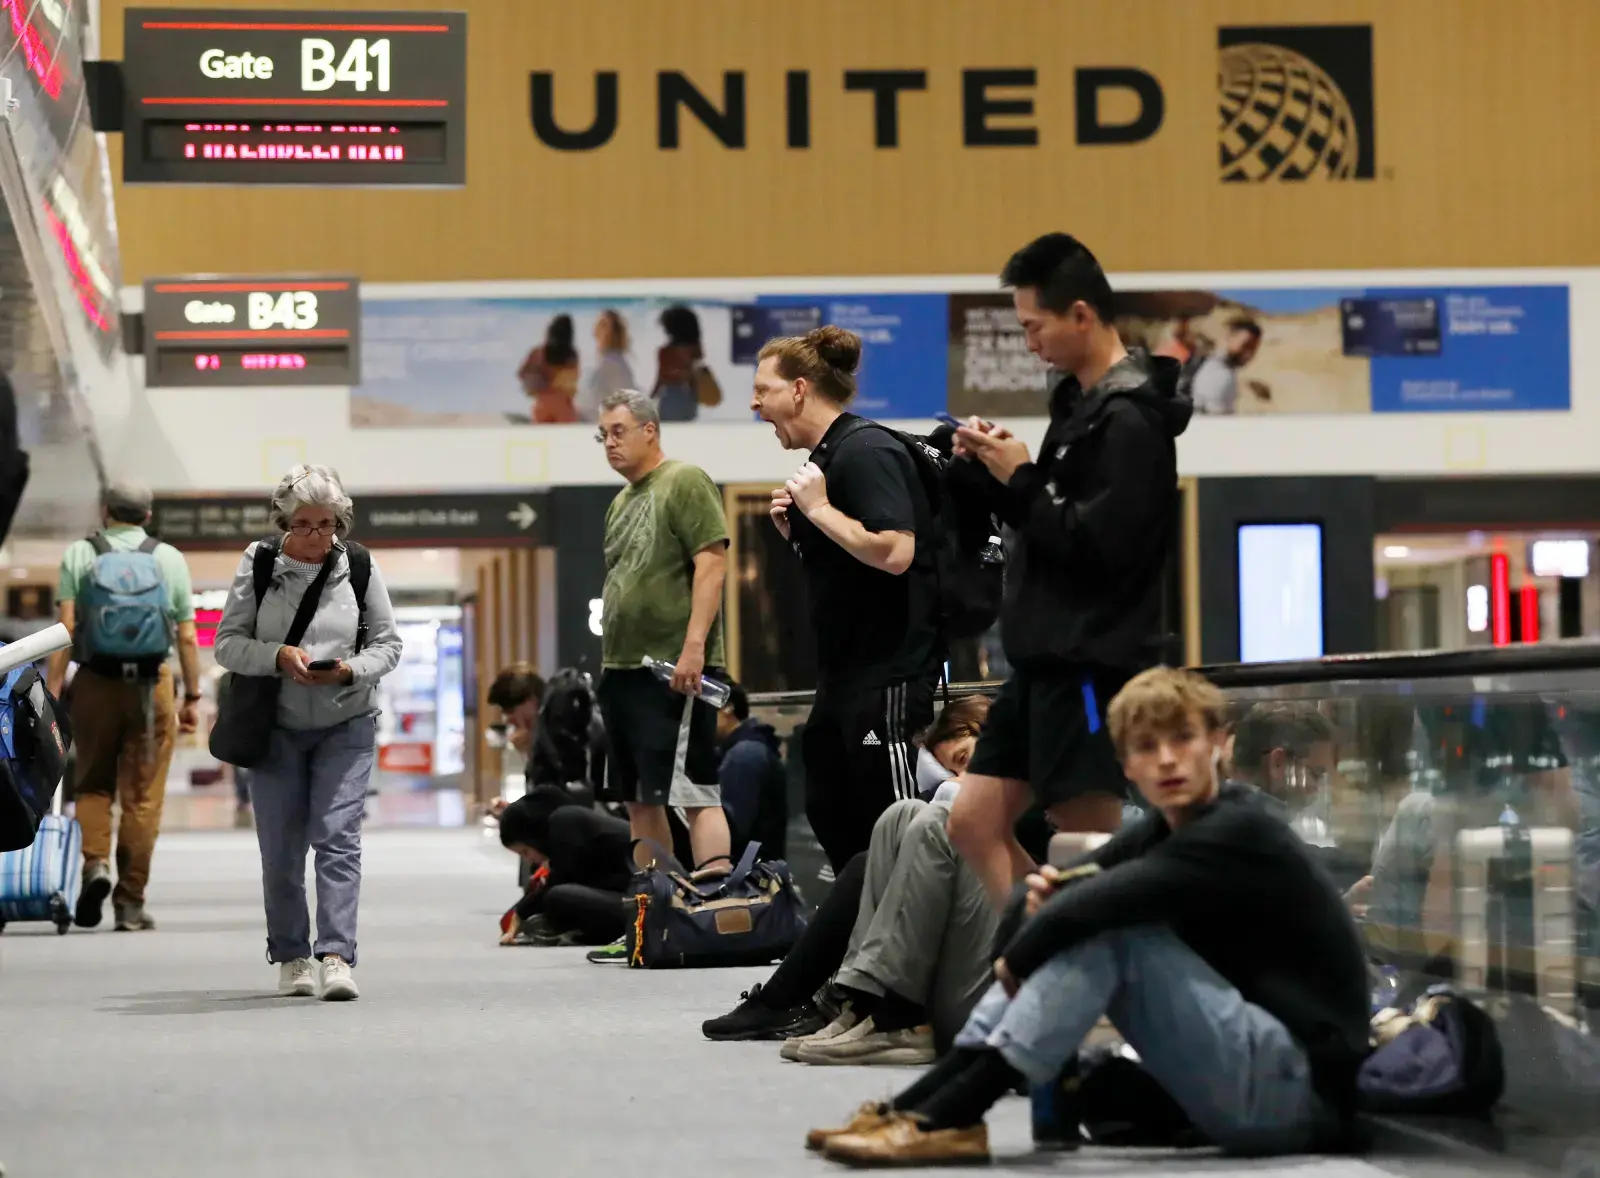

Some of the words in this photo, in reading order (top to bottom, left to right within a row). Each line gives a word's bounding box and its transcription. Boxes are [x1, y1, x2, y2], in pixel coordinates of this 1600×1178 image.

[200, 49, 273, 80] Gate
[301, 38, 391, 92] B41
[529, 67, 1165, 152] UNITED
[184, 300, 236, 324] Gate
[248, 291, 318, 331] B43
[862, 738, 882, 746] adidas
